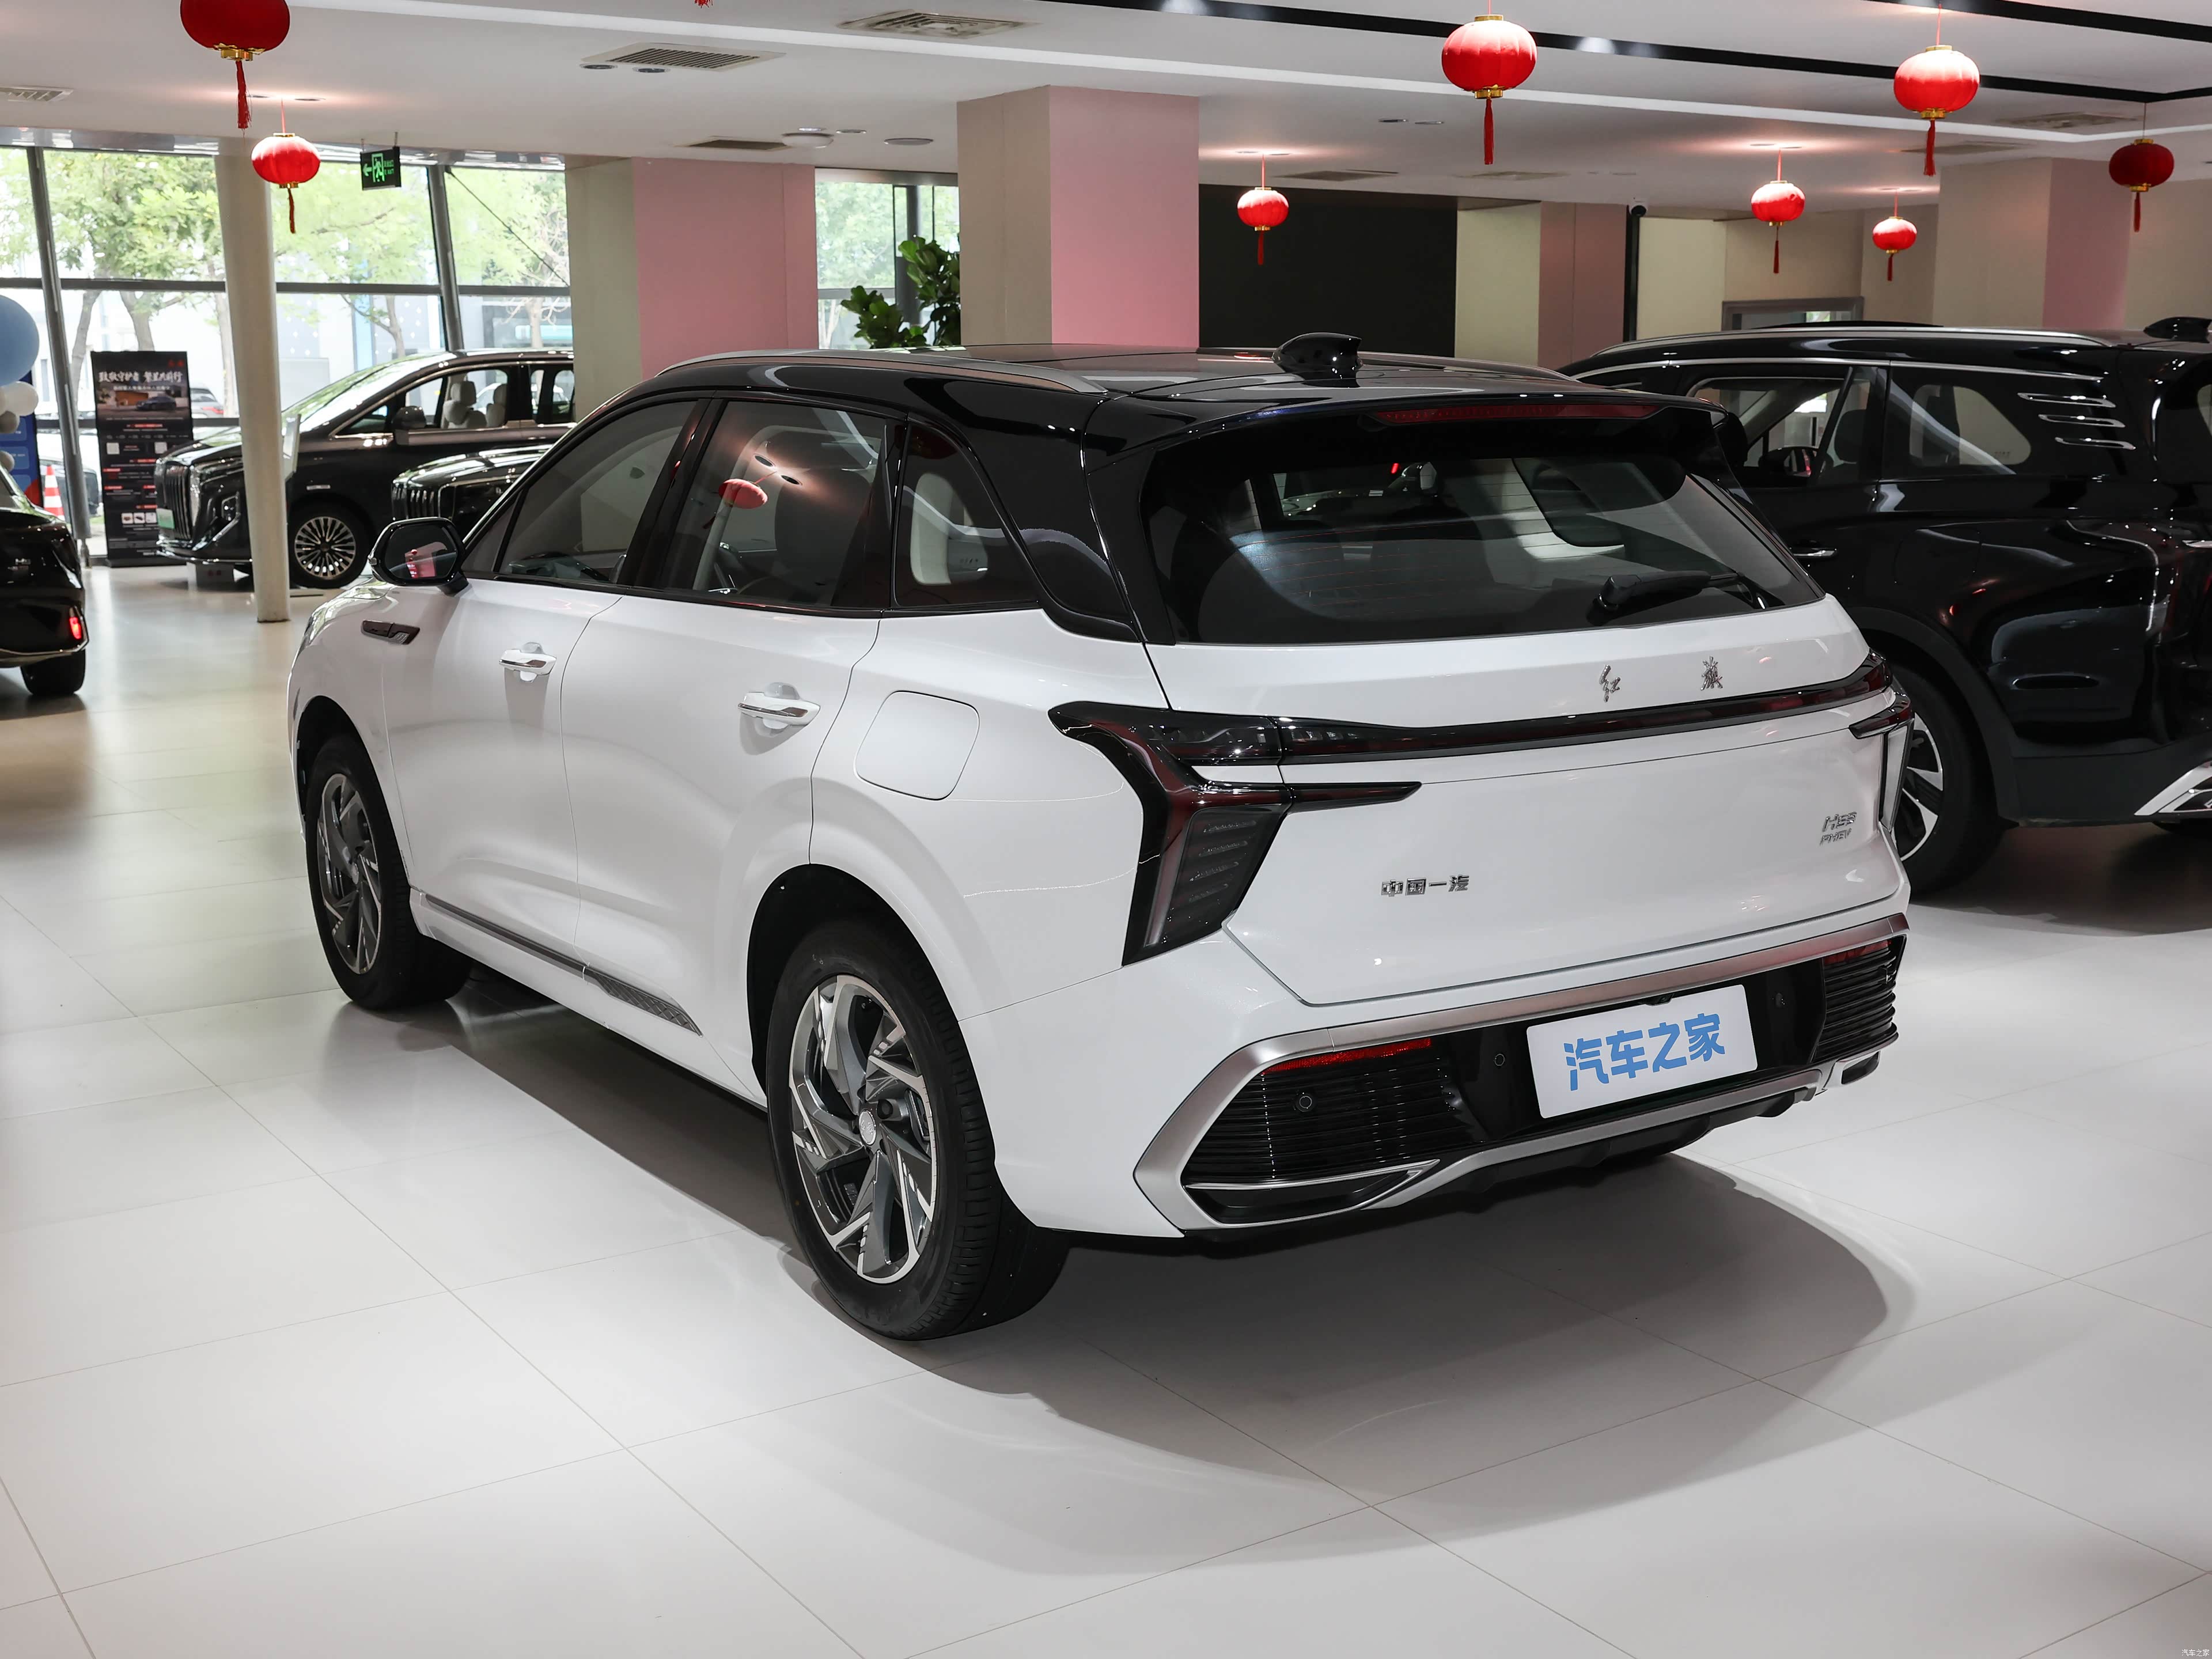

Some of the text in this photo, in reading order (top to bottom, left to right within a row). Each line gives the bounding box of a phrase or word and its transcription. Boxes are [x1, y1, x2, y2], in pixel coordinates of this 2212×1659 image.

[1819, 828, 1852, 846] PHEV
[1381, 874, 1469, 897] 中国一汽
[1563, 1013, 1725, 1091] 汽车之家
